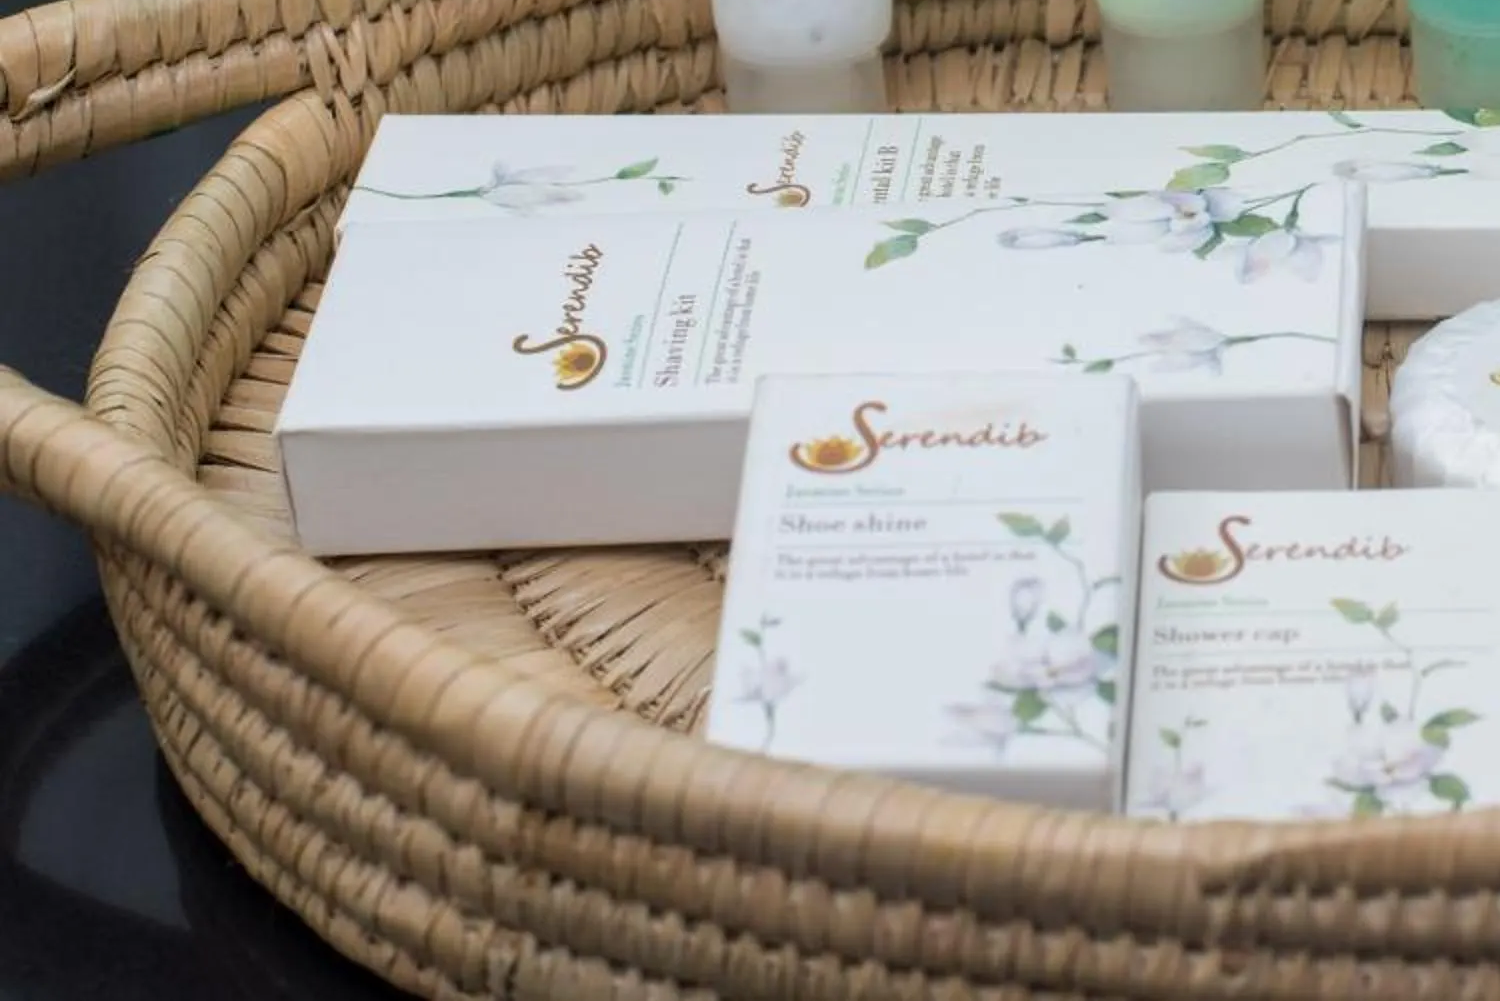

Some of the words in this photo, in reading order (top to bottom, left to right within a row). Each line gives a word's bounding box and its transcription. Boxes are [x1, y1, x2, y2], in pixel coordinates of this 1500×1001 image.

[877, 145, 898, 155] B
[871, 157, 896, 174] kit
[512, 242, 608, 391] Serendib
[669, 294, 697, 317] kit
[654, 318, 698, 388] Shaving
[788, 400, 1049, 474] Serendib
[778, 511, 847, 535] Shoe
[852, 510, 929, 534] shine
[1158, 515, 1412, 585] Serendib
[1153, 625, 1247, 646] Shower
[1252, 627, 1301, 646] cap
